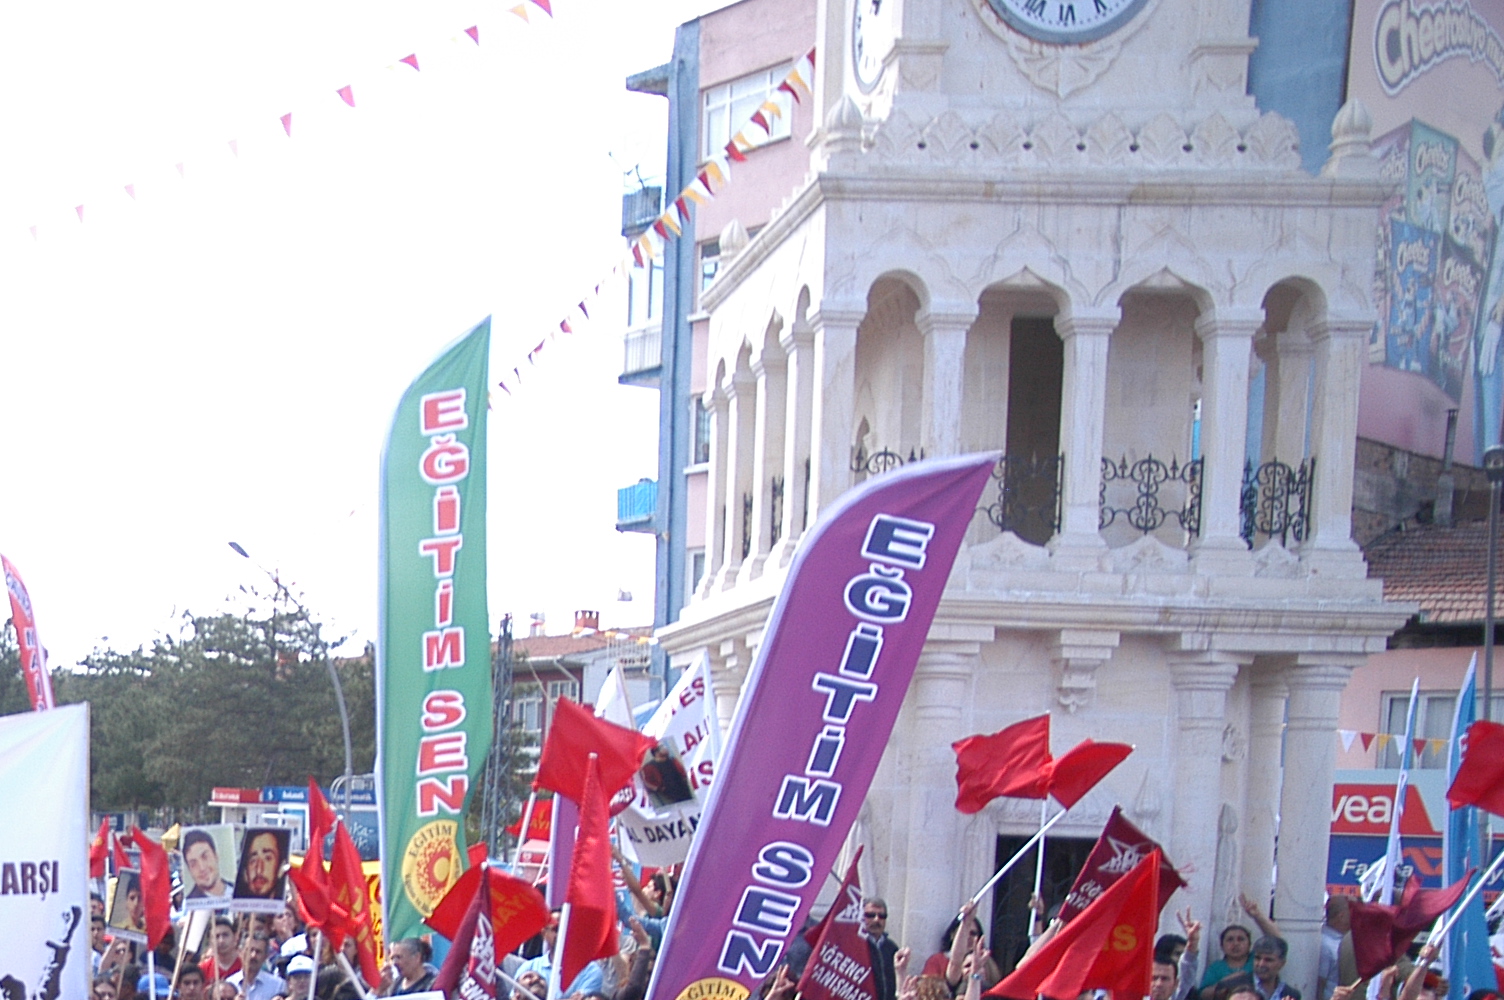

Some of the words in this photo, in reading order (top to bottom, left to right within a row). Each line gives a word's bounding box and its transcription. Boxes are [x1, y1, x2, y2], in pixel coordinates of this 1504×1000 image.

[419, 389, 469, 670] EĞİTİM
[773, 514, 935, 826] EĞİTİM
[416, 689, 469, 815] SEN
[1331, 794, 1393, 823] vea
[718, 841, 814, 979] SEN
